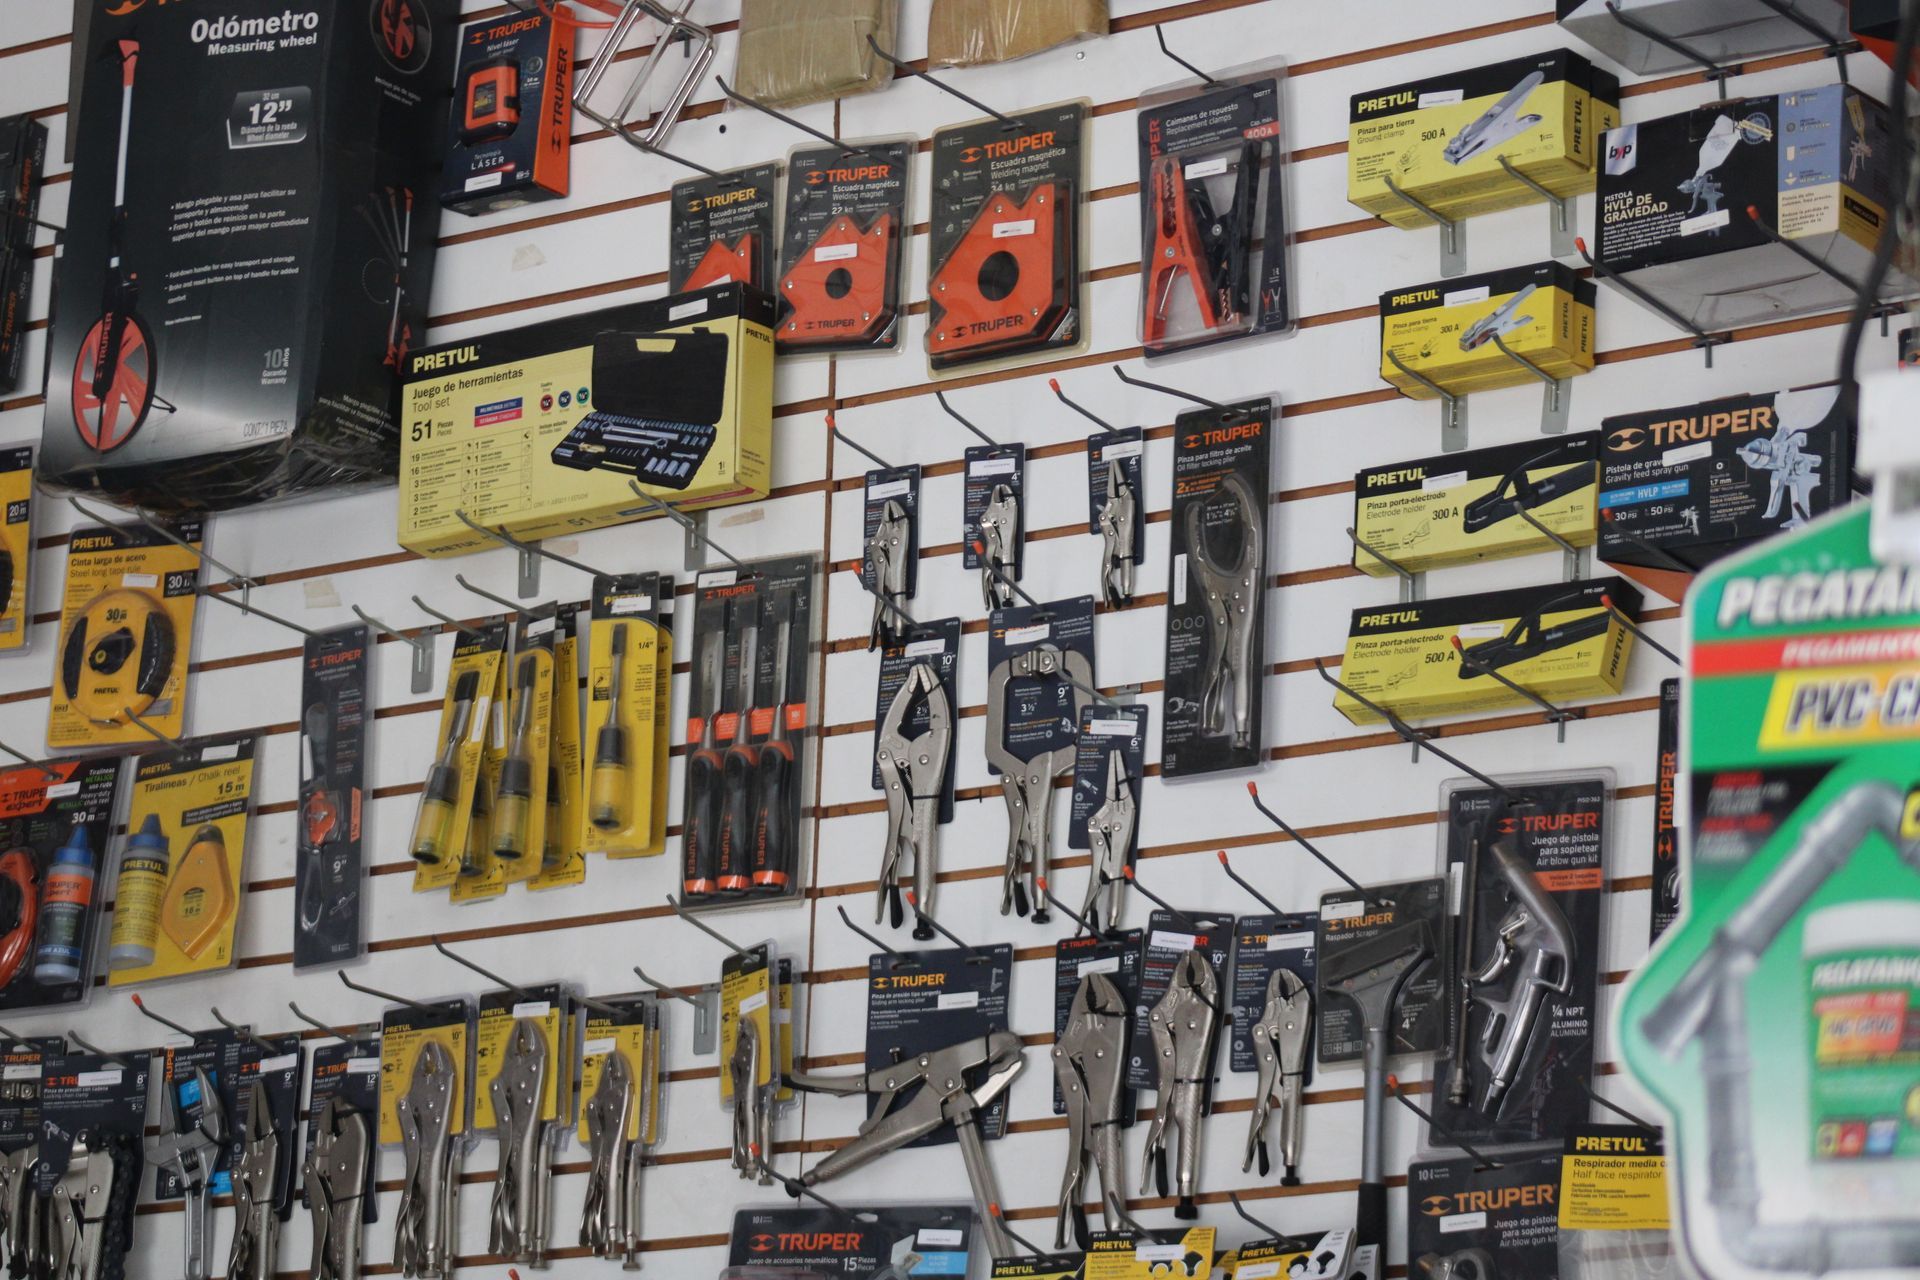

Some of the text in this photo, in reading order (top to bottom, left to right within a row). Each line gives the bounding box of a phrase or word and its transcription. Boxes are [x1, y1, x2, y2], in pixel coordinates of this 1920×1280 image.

[191, 10, 319, 43] Odómetro
[487, 16, 543, 44] TRUPER
[207, 32, 317, 56] Measuring wheel
[552, 47, 568, 124] TRUPER
[1358, 91, 1416, 114] PRETUL
[1166, 113, 1198, 127] Caimanes
[1209, 104, 1239, 118] repuesto
[1166, 114, 1232, 135] Replacement clamps
[1358, 118, 1414, 136] Pinza para tierra
[1574, 97, 1583, 154] PRETUL
[1358, 129, 1405, 144] Ground clamp
[1421, 128, 1446, 141] 500 A
[983, 131, 1056, 159] TRUPER
[471, 155, 505, 170] LÁSER
[990, 148, 1066, 170] Escuadra magnética
[826, 164, 891, 183] TRUPER
[991, 162, 1050, 179] Welding magnet
[833, 180, 900, 193] Escuadra magnética
[260, 190, 286, 198] facilitar
[703, 187, 757, 209] TRUPER
[832, 193, 860, 202] Welding
[1605, 191, 1632, 202] PISTOLA
[210, 204, 249, 214] almacenaje
[1604, 193, 1652, 213] HVLP DE
[267, 210, 286, 219] parte
[1604, 202, 1668, 223] GRAVEDAD
[271, 217, 309, 227] comodidad
[1392, 289, 1438, 307] PRETUL
[817, 318, 855, 329] TRUPER
[969, 314, 1023, 336] TRUPER
[1440, 326, 1453, 334] 300
[746, 328, 771, 344] PRETUL
[412, 345, 479, 374] PRETUL
[413, 368, 524, 400] Juego de herramientas
[412, 396, 450, 412] Tool set
[411, 419, 432, 442] 51
[1649, 407, 1775, 446] TRUPER
[1203, 423, 1262, 445] TRUPER
[1177, 455, 1194, 464] Pinza
[1195, 453, 1208, 461] para
[1234, 445, 1252, 453] aceite
[1605, 464, 1688, 484] Gravity feed spray gun
[1606, 461, 1643, 474] Pistola de
[1367, 468, 1426, 487] PRETUL
[1638, 488, 1658, 499] HVLP
[1367, 492, 1446, 510] Pinza porta-electrodo
[1367, 505, 1425, 519] Electrode holder
[1432, 507, 1458, 520] 300 A
[1615, 512, 1627, 521] 30
[1651, 506, 1662, 515] 50
[72, 536, 114, 549] PRETUL
[71, 558, 91, 566] Cinta
[94, 557, 112, 566] larga
[126, 554, 146, 562] acero
[70, 569, 90, 578] Steel
[168, 576, 182, 589] 30
[717, 584, 755, 597] TRUPER
[106, 608, 119, 621] 30
[1359, 611, 1420, 627] PRETUL
[1355, 634, 1444, 649] Pinza porta-electrodo
[455, 644, 481, 655] PRETUL
[1353, 645, 1421, 659] Electrode holder
[1610, 626, 1625, 678] PRETUL
[321, 651, 361, 666] TRUPER
[1425, 651, 1455, 664] 500 A
[141, 763, 172, 776] PRETUL
[218, 782, 232, 794] 15
[1659, 752, 1676, 832] TRUPER
[6, 801, 42, 811] expert
[72, 812, 86, 823] 30
[1523, 813, 1597, 832] TRUPER
[1532, 833, 1599, 846] Juego de pistola
[1540, 844, 1598, 856] para sopletear
[124, 860, 162, 872] PRETUL
[1536, 854, 1598, 865] Air blow gun kit
[1343, 912, 1393, 929] TRUPER
[1326, 929, 1378, 941] Raspador Scraper
[891, 973, 945, 987] TRUPER
[481, 1008, 506, 1017] PRETUL
[1565, 1007, 1584, 1016] NPT
[385, 1024, 411, 1033] PRETUL
[1552, 1019, 1587, 1028] ALUMINIO
[1551, 1028, 1587, 1037] ALUMINUM
[4, 1054, 40, 1062] TRUPER
[1576, 1137, 1646, 1151] PRETUL
[1574, 1159, 1657, 1168] Respirador media
[1573, 1170, 1662, 1180] Half face respirator
[1454, 1184, 1554, 1212] TRUPER
[1495, 1216, 1557, 1229] Juego de pistola
[1502, 1226, 1557, 1238] para sopletear
[777, 1233, 861, 1251] TRUPER
[1093, 1240, 1132, 1249] PRETUL
[1512, 1238, 1530, 1247] blow
[1532, 1238, 1545, 1246] gun
[1242, 1246, 1276, 1258] PRETUL
[804, 1256, 837, 1264] neumáticos
[843, 1257, 857, 1271] 15
[859, 1256, 876, 1264] Piezas
[995, 1265, 1034, 1276] PRETUL
